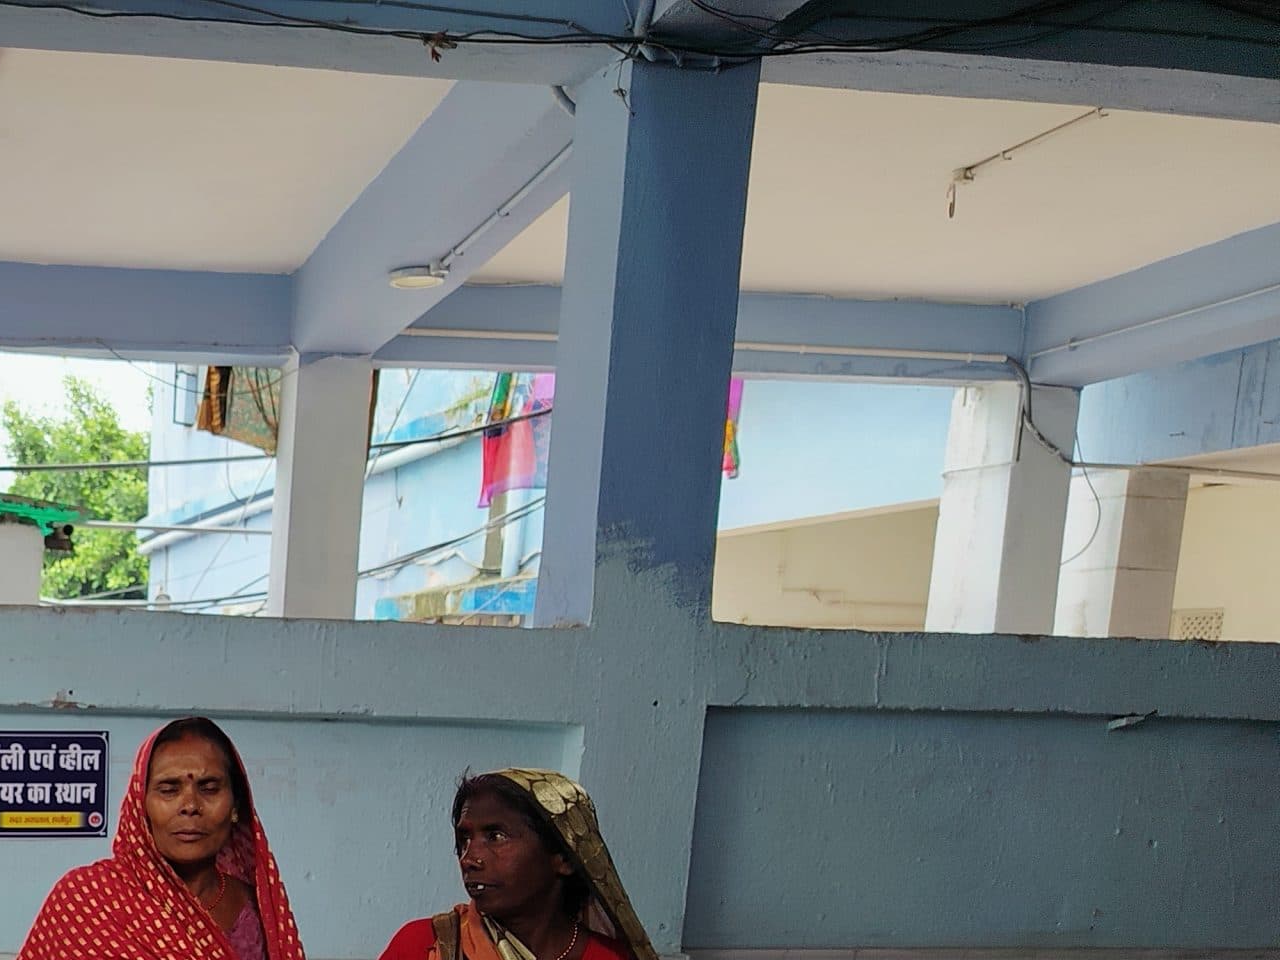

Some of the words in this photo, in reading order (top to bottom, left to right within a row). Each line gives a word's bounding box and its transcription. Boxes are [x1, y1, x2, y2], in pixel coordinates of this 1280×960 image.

[28, 743, 57, 771] एवं
[59, 743, 102, 771] व्हील
[26, 783, 52, 804] का
[54, 783, 98, 804] स्थान
